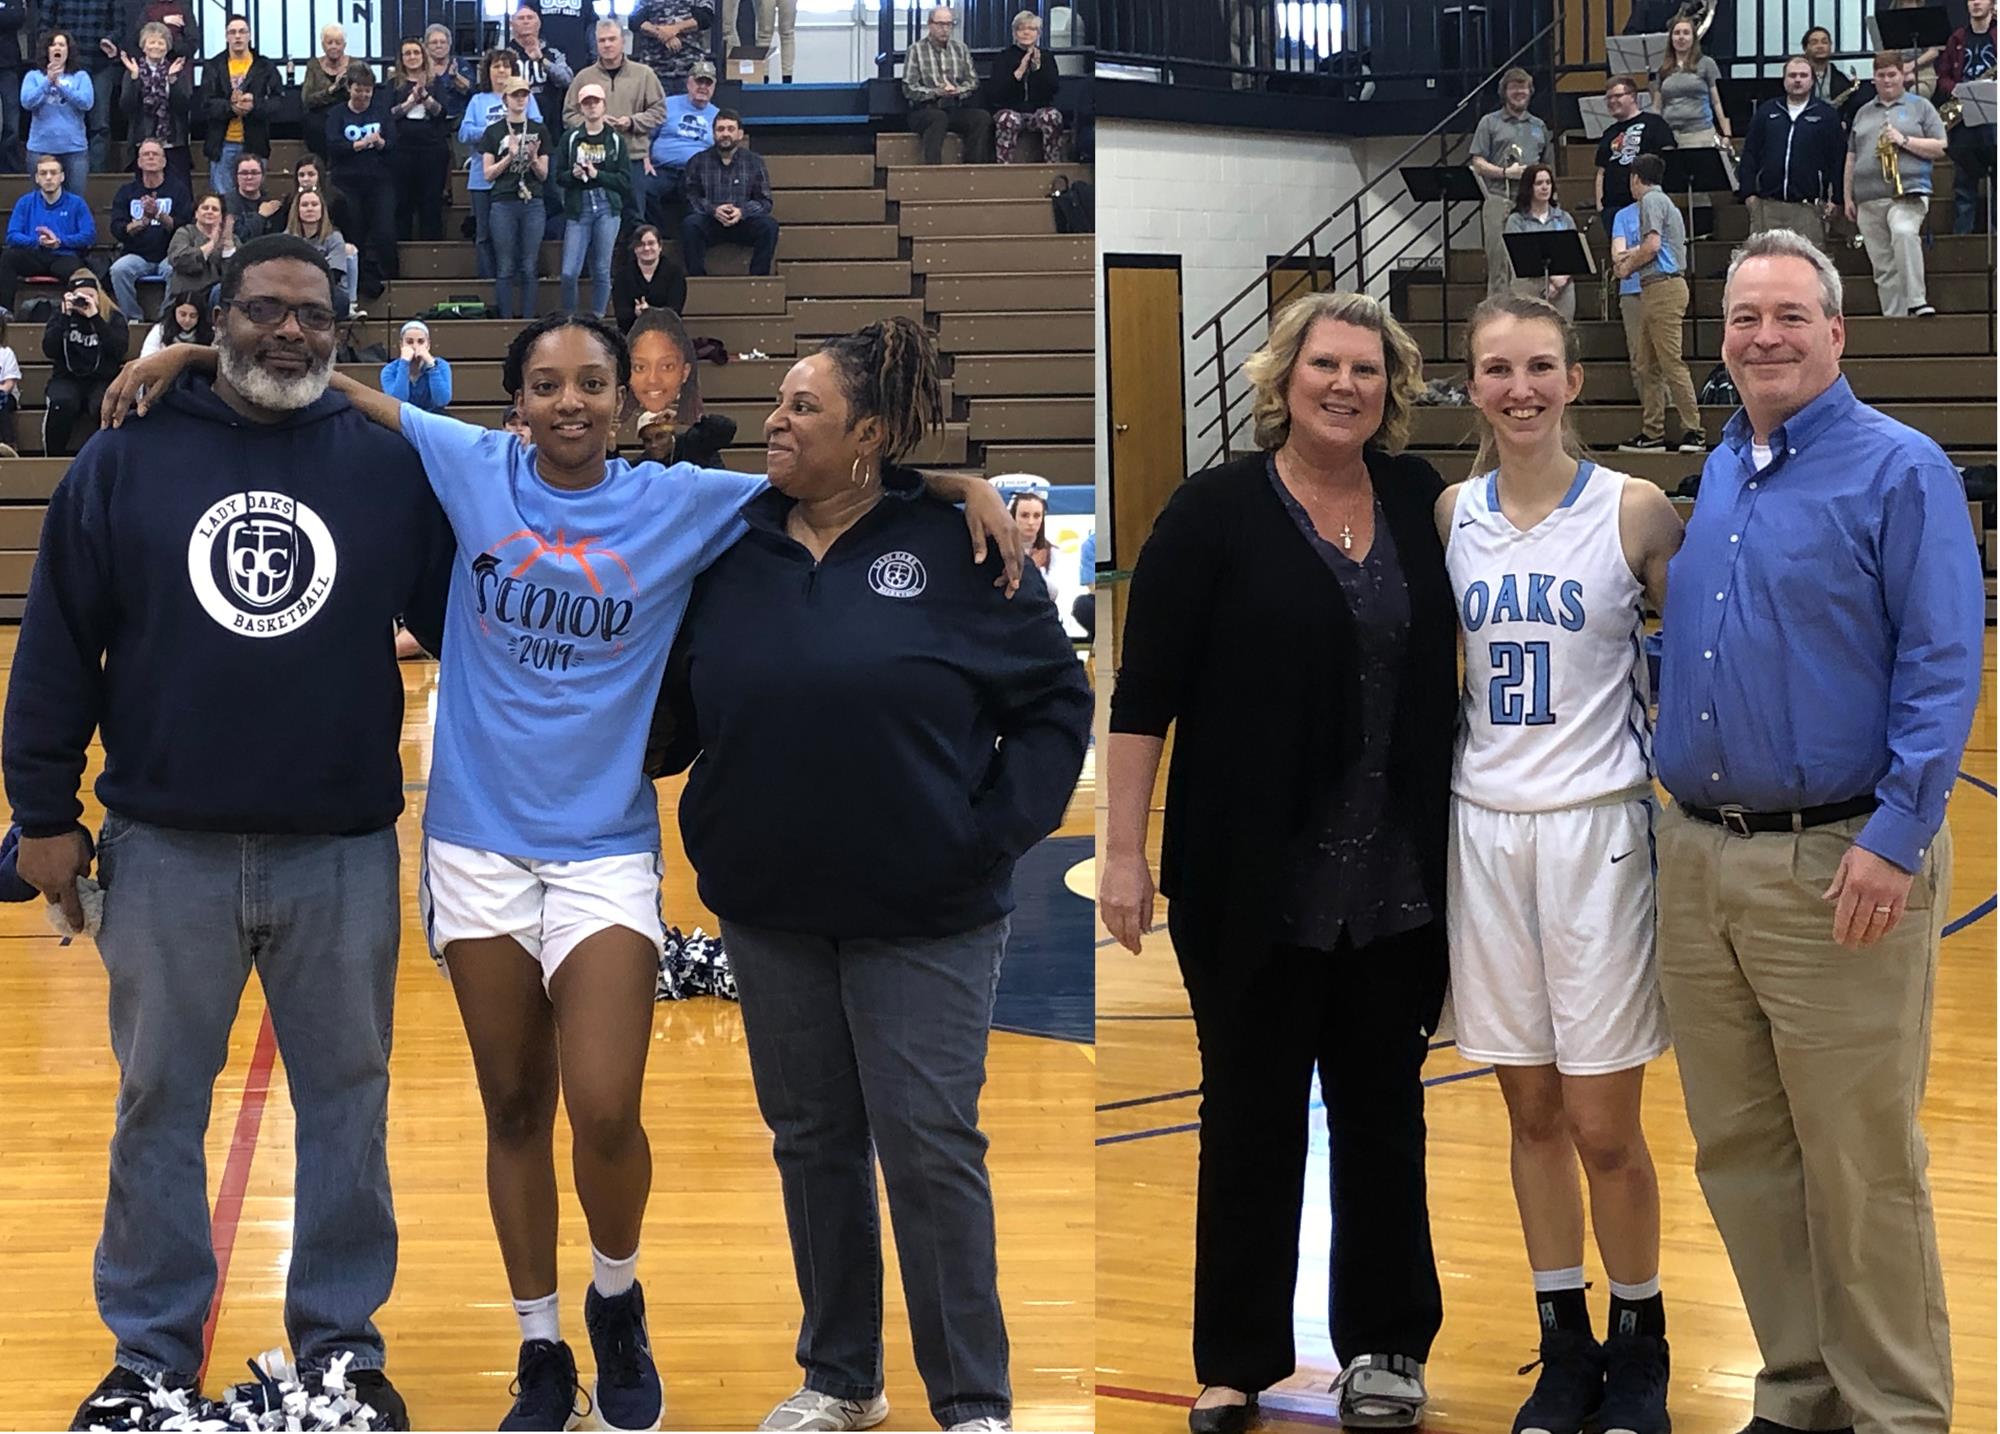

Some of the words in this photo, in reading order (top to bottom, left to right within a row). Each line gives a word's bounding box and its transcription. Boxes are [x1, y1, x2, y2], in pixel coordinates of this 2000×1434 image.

[199, 499, 239, 539] LADY
[248, 496, 294, 515] OAKS
[233, 575, 330, 633] BASKETBALL
[472, 568, 634, 642] SENIOR
[1463, 572, 1586, 632] OAKS
[519, 634, 575, 672] 2019
[1489, 640, 1556, 725] 21
